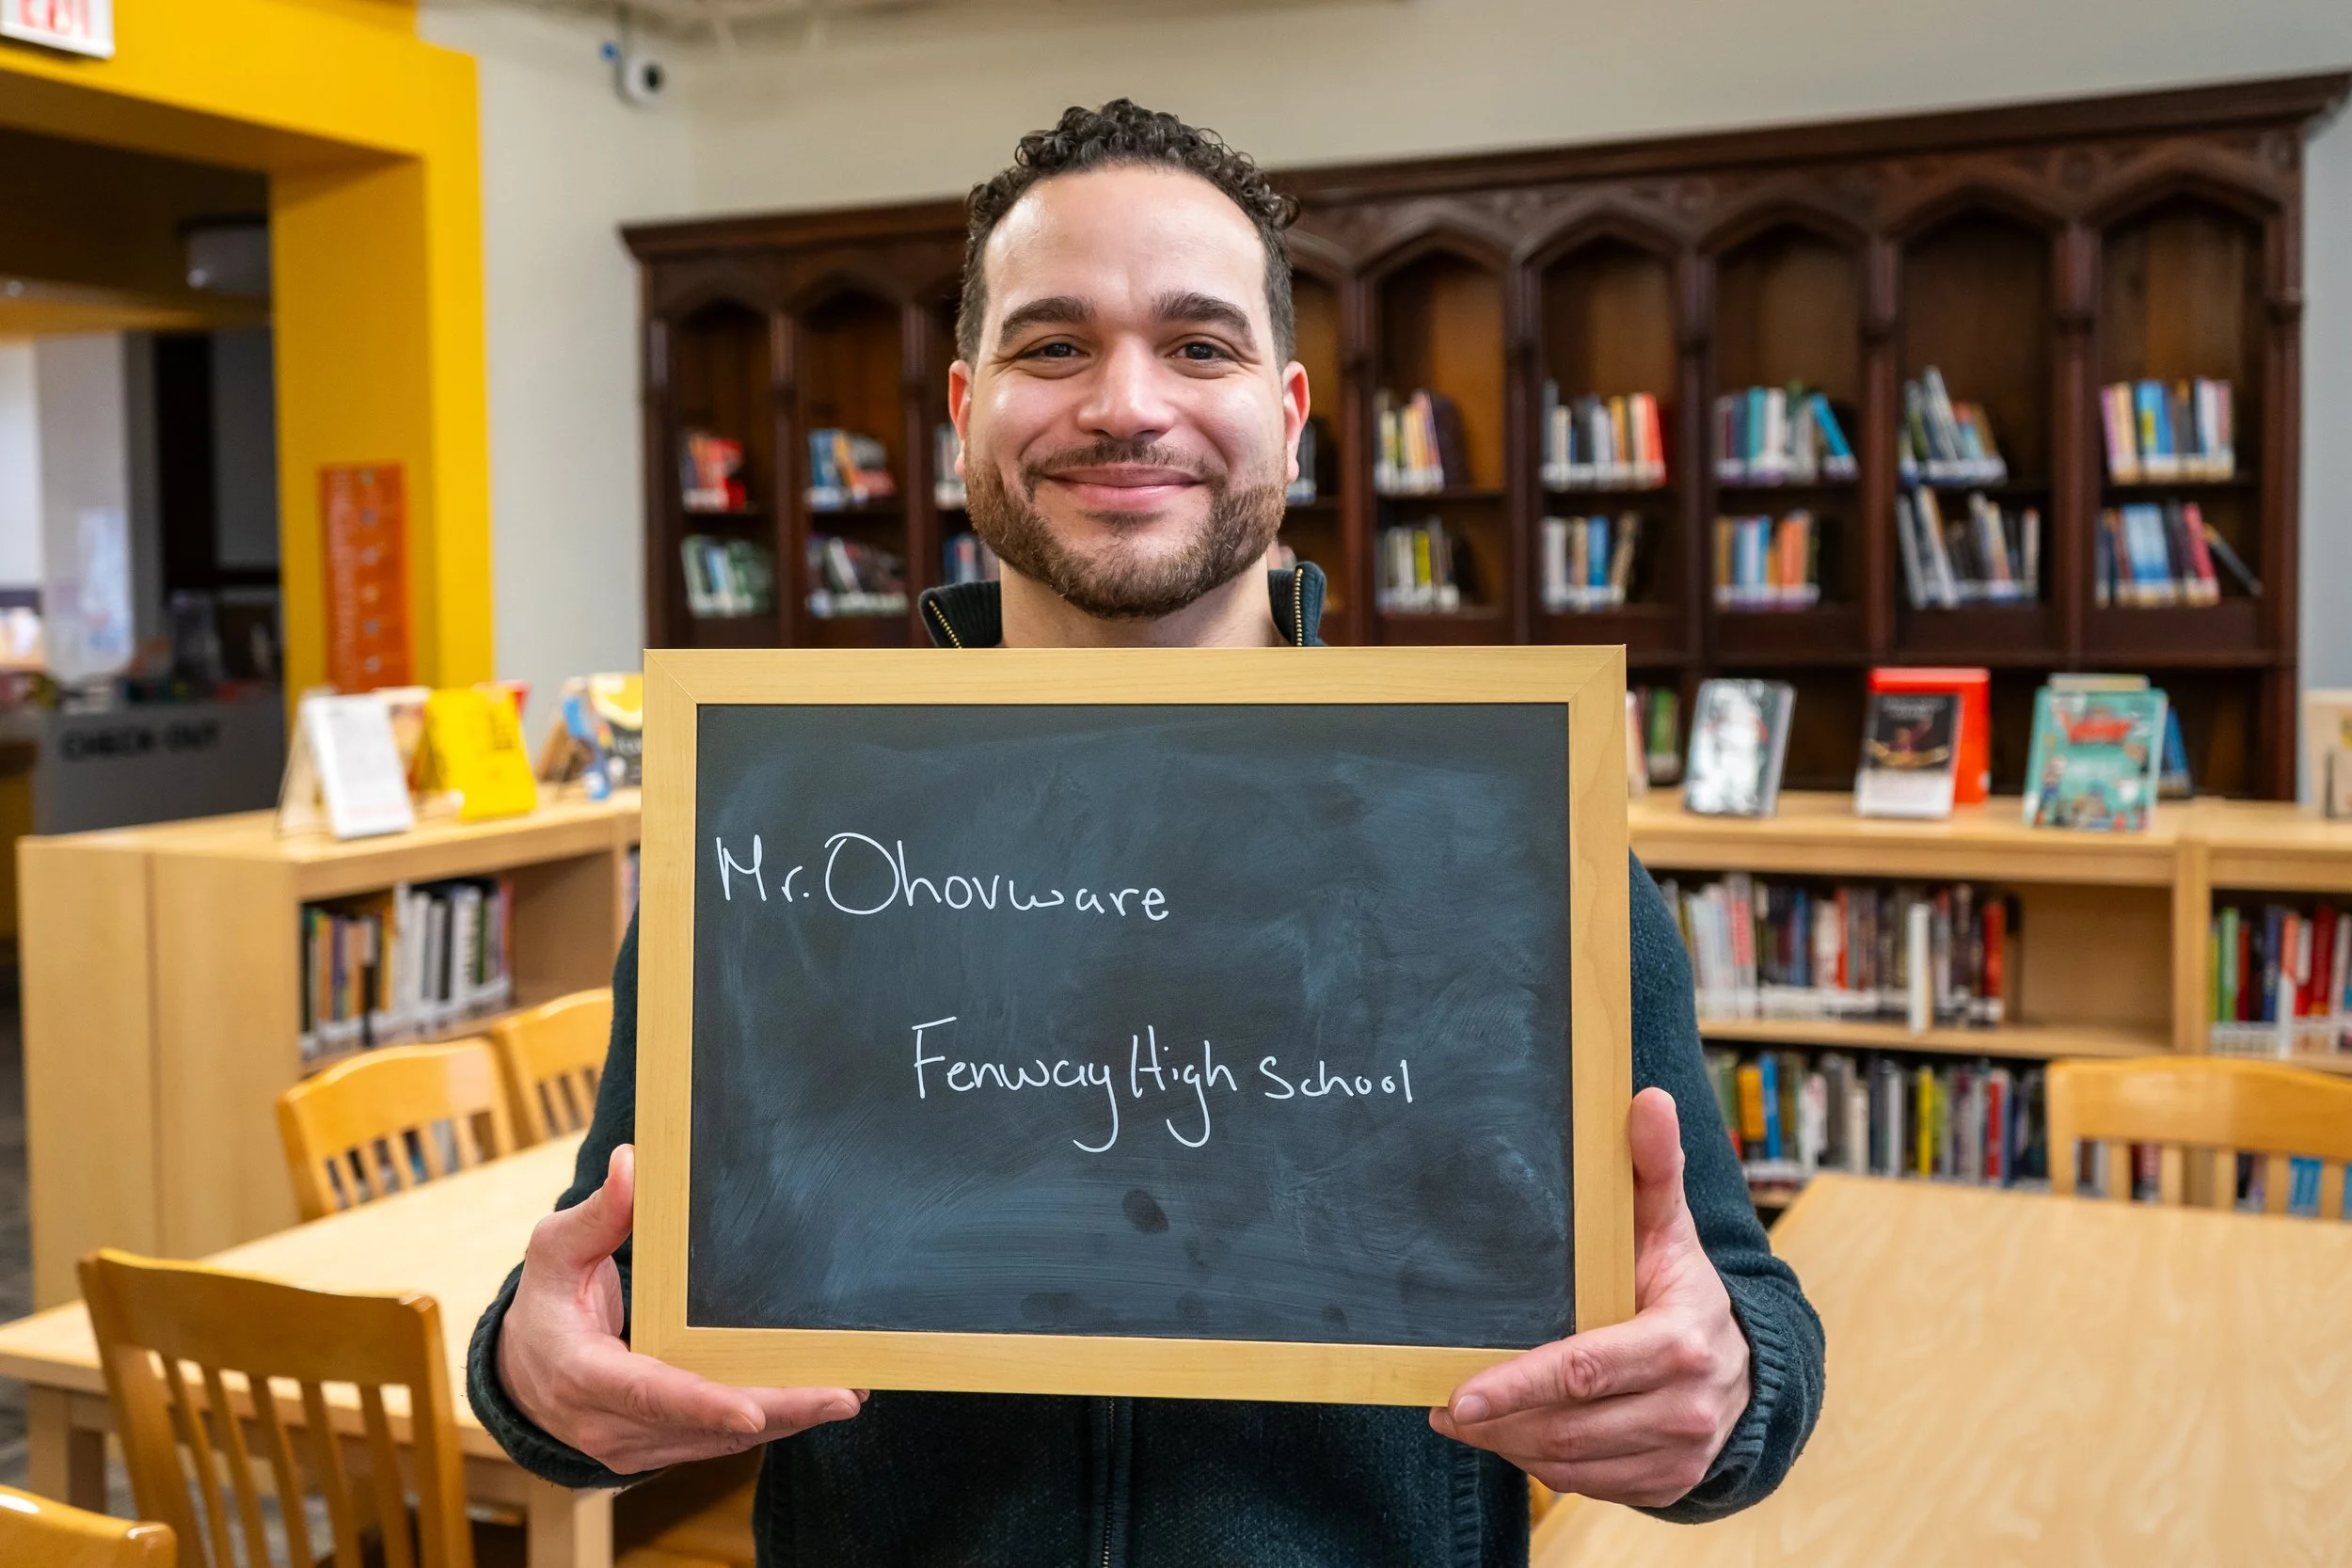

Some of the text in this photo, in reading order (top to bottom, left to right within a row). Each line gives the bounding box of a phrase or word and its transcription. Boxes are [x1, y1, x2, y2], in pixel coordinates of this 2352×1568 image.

[715, 831, 1169, 922] Mr. Ohovware
[910, 1015, 1119, 1154] Fenway
[1129, 1024, 1239, 1148] High
